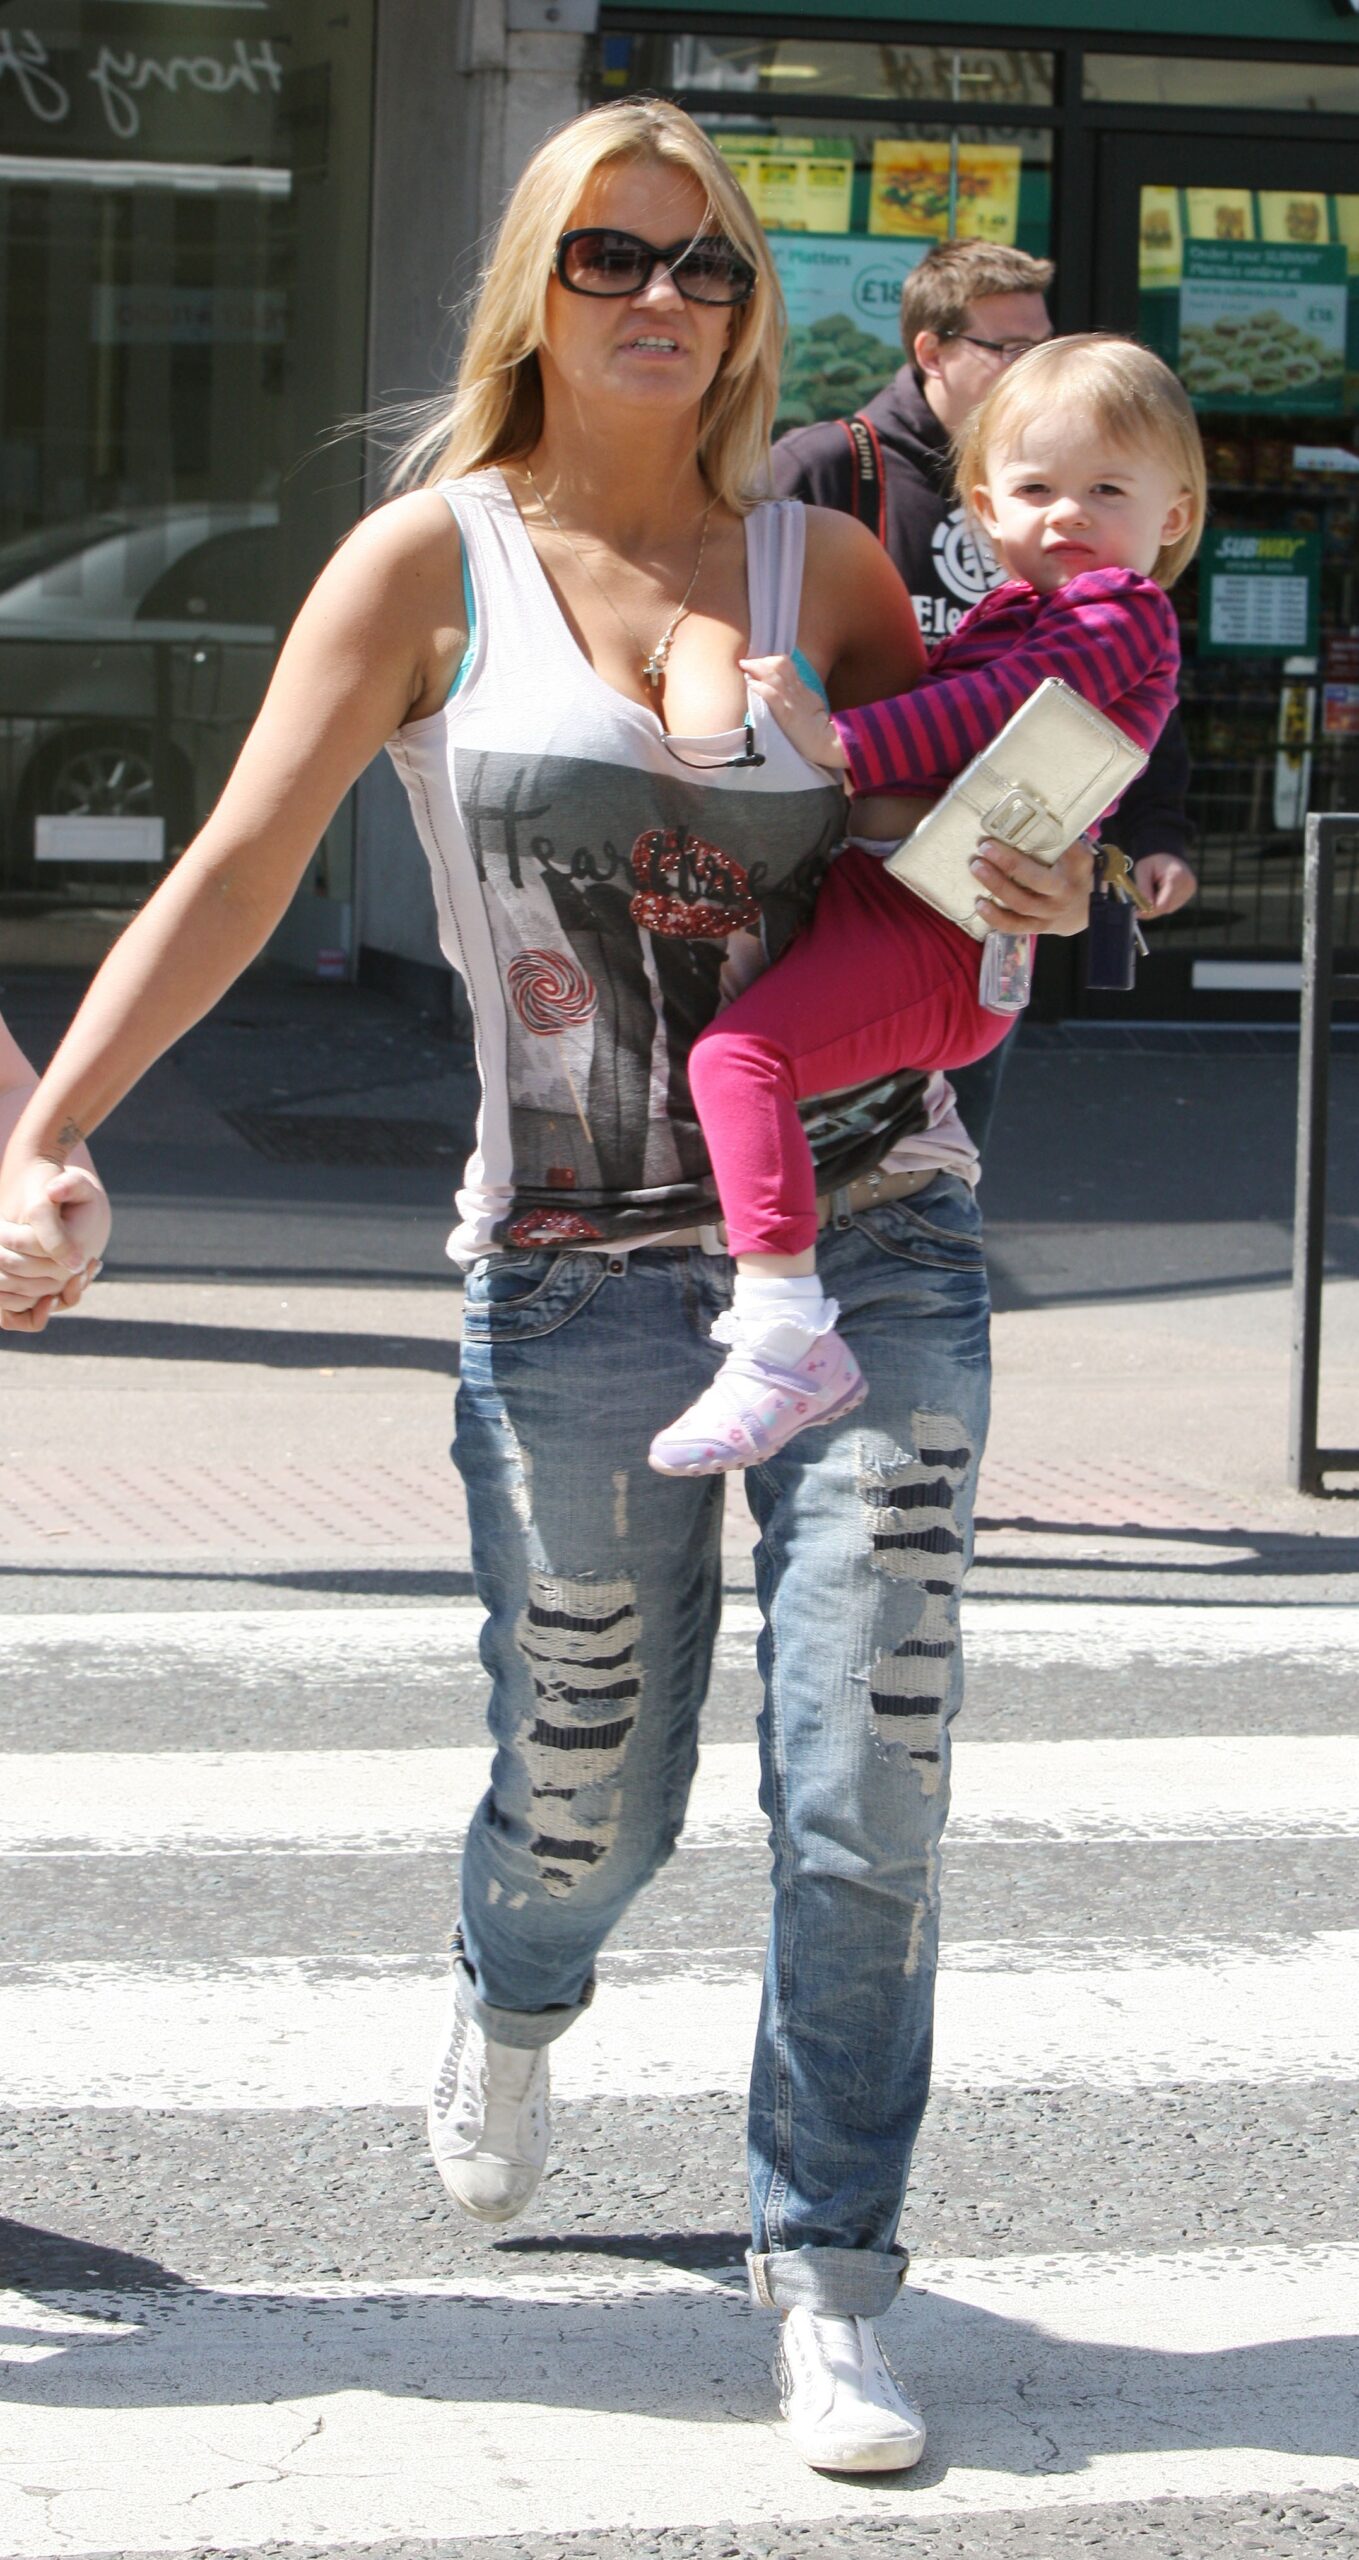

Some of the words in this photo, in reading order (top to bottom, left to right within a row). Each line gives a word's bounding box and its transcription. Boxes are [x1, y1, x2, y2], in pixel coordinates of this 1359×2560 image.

[788, 248, 852, 267] Platters
[849, 420, 875, 481] Canon
[1215, 536, 1306, 558] SUBWAY
